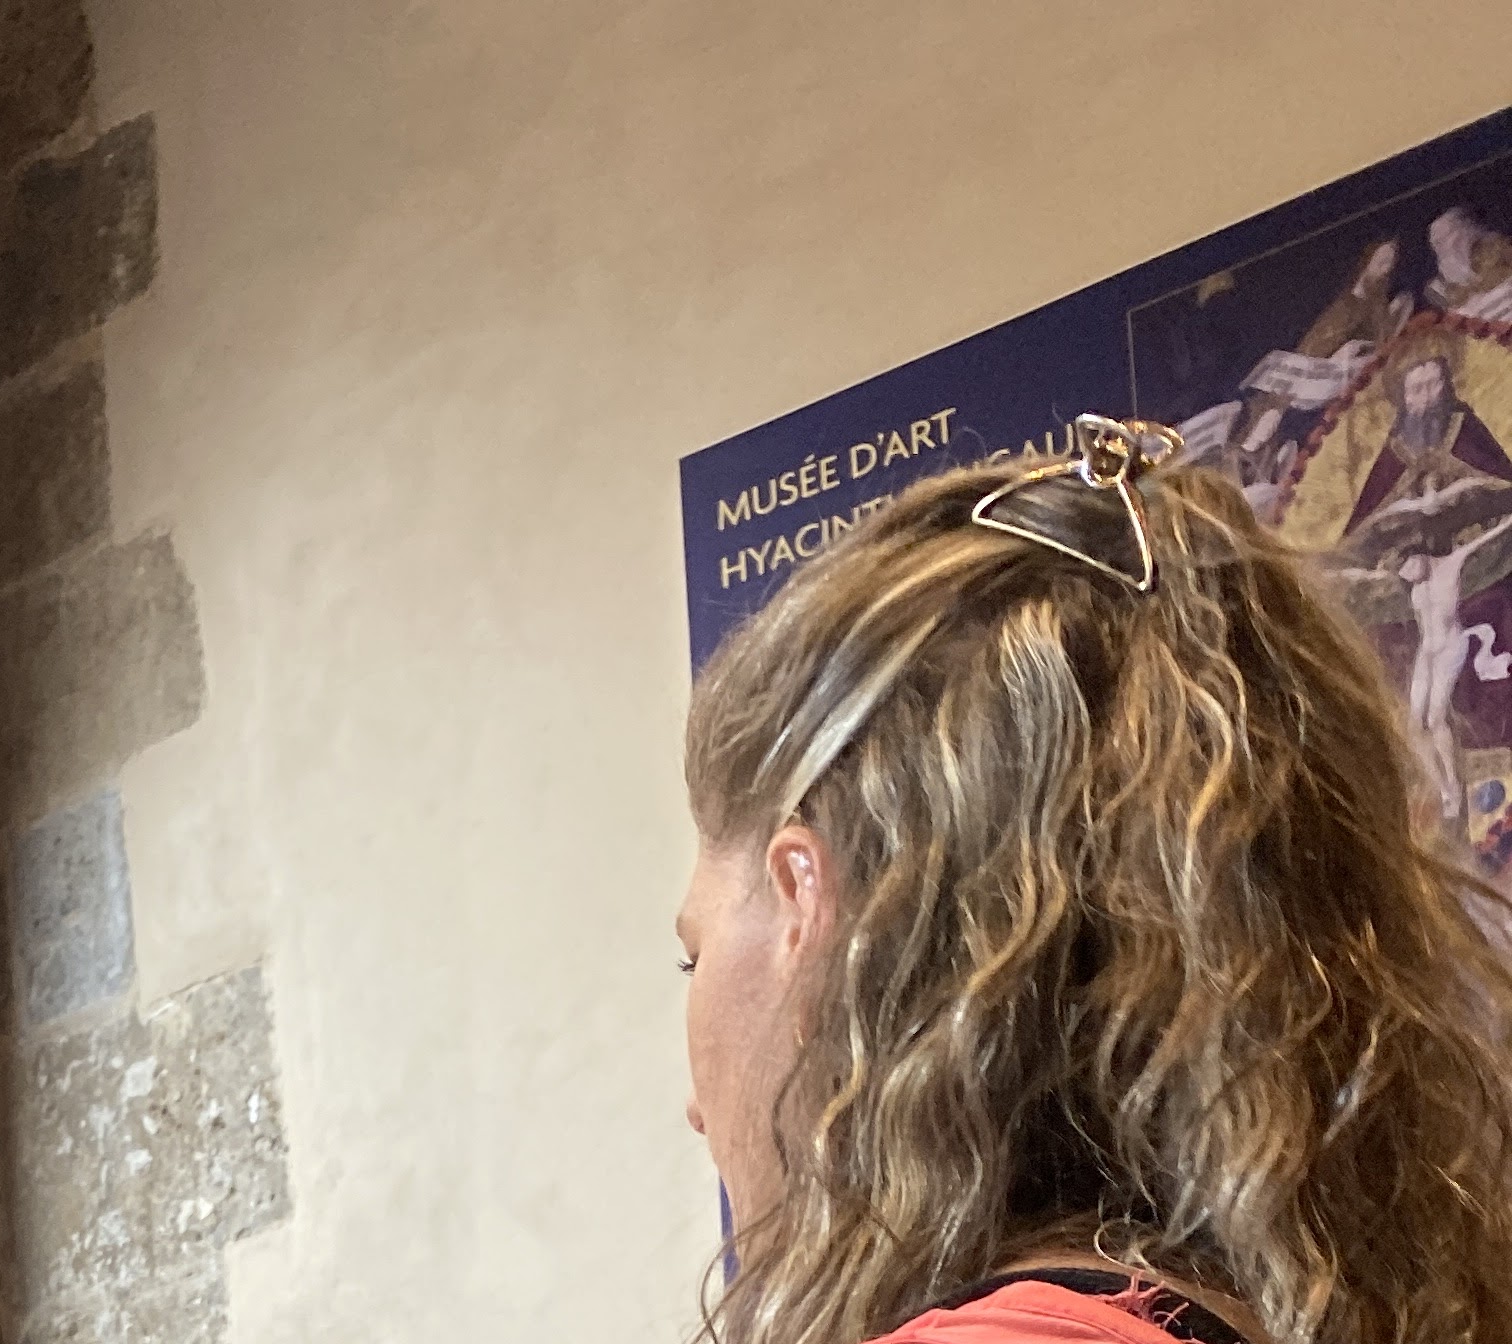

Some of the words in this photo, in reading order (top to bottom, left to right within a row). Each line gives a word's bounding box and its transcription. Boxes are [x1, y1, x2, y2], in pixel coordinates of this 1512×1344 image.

[716, 454, 841, 532] MUSÉE
[850, 407, 958, 480] D'ART
[720, 494, 894, 590] HYACINT
